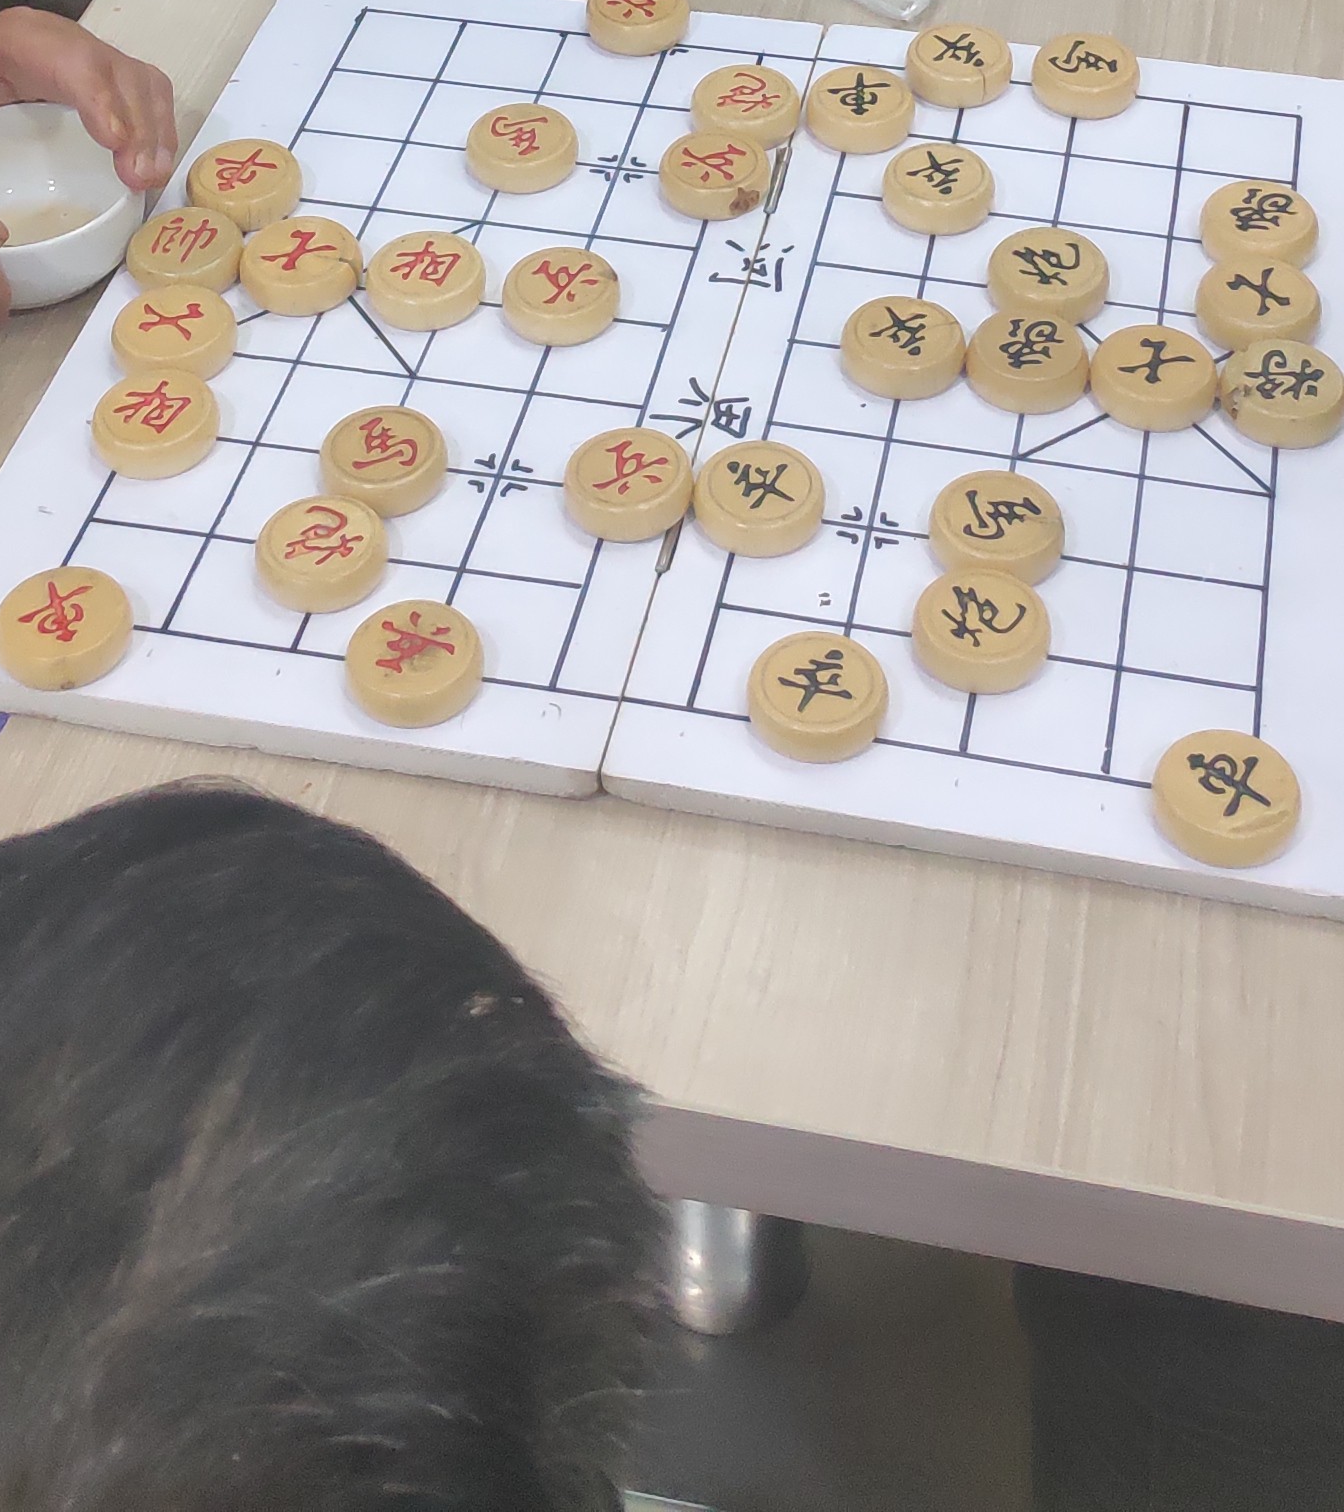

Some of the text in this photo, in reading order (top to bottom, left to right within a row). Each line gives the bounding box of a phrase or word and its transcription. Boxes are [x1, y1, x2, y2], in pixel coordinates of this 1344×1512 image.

[933, 33, 985, 67] 卒
[682, 144, 746, 181] 兵
[906, 149, 964, 195] 卒
[392, 241, 461, 287] 相
[535, 260, 598, 304] 兵
[650, 239, 795, 439] 河 界
[869, 306, 928, 356] 卒
[115, 380, 192, 435] 相
[594, 440, 668, 494] 兵
[726, 461, 795, 510] 卒
[375, 611, 456, 674] 兵
[777, 649, 853, 712] 卒
